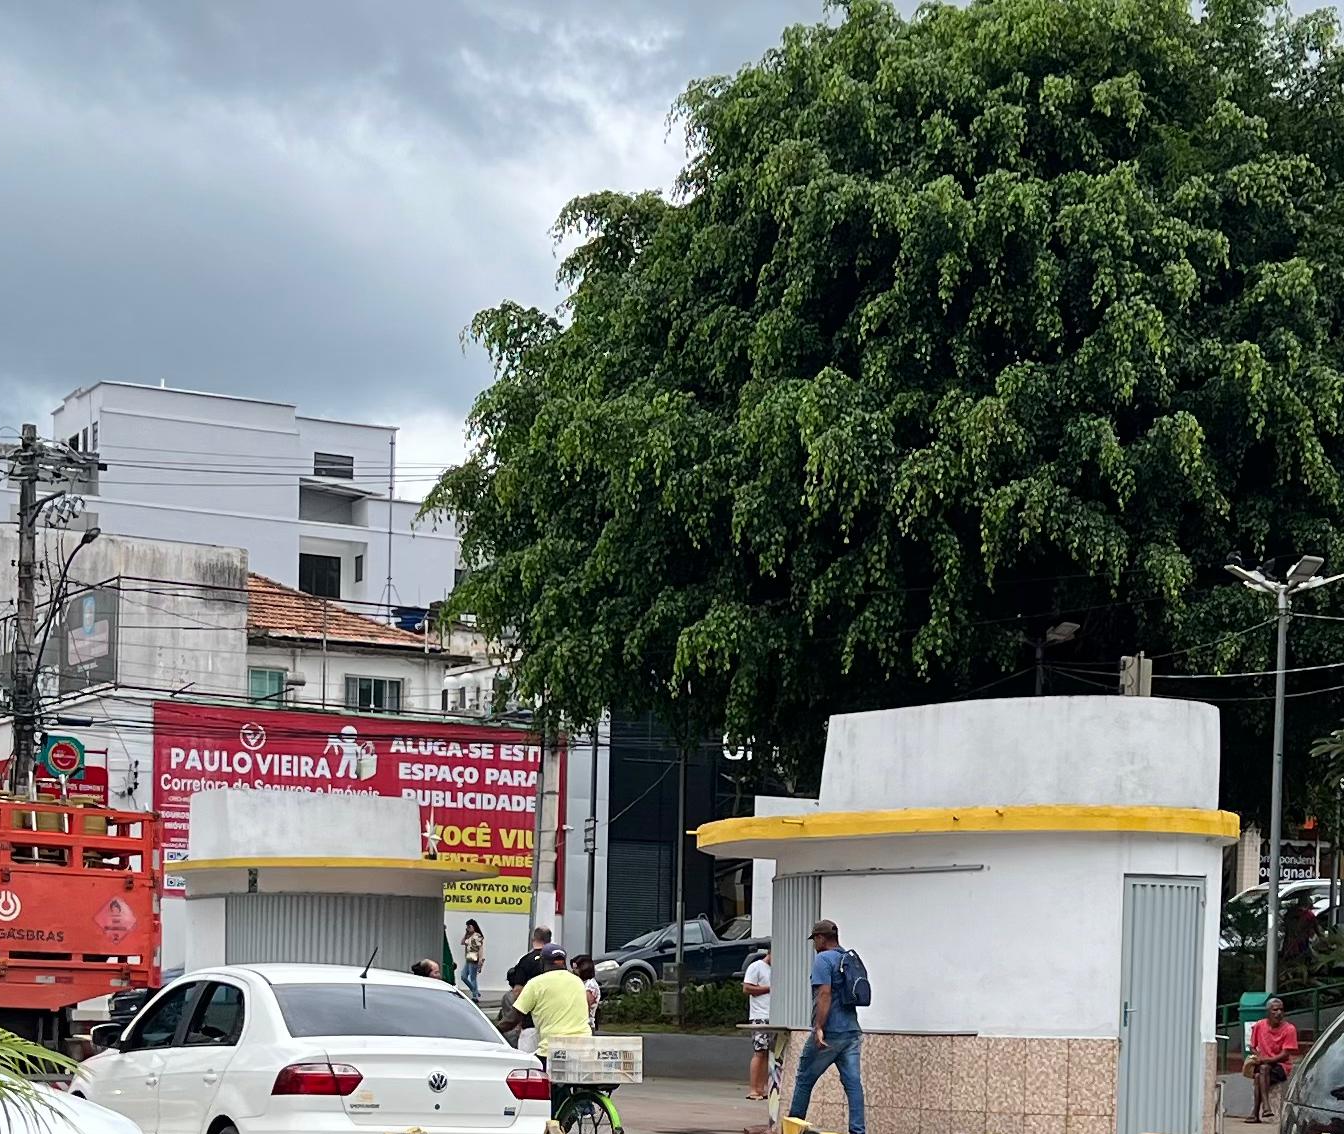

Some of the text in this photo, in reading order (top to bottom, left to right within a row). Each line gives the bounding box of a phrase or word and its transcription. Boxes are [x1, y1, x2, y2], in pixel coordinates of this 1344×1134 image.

[390, 737, 495, 760] ALUGA-SE
[170, 747, 332, 779] PAULO VIEIRA
[160, 773, 229, 792] Corretora
[398, 762, 538, 788] ESPAÇO PARA
[401, 788, 537, 813] PUBLICIDADE
[483, 853, 534, 868] TAMBÉ
[460, 883, 509, 893] CONTATO
[475, 896, 491, 905] AO
[494, 897, 523, 906] LADO
